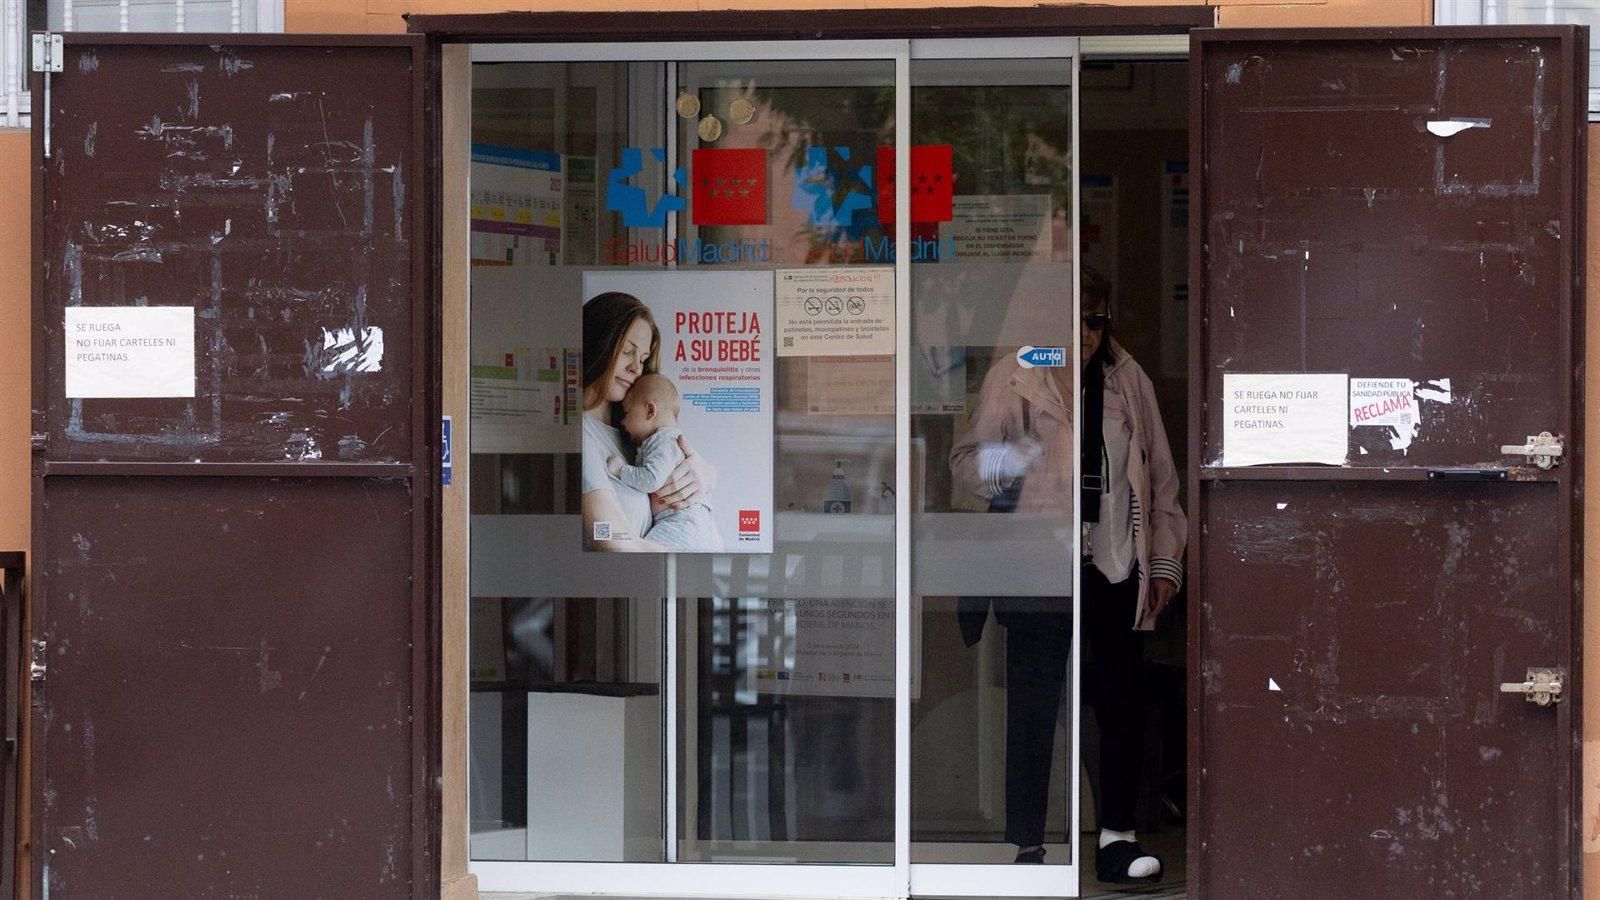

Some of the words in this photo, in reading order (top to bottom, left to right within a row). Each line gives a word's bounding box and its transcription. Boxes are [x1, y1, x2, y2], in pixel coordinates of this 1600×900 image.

[675, 311, 760, 334] PROTEJA
[76, 323, 87, 332] SE
[89, 323, 121, 332] RUEGA
[77, 339, 91, 347] NO
[94, 339, 117, 347] FIJAR
[119, 338, 163, 347] CARTELES
[166, 338, 176, 346] NI
[674, 340, 686, 361] A
[691, 340, 712, 361] SU
[718, 335, 760, 361] BEBÉ
[1032, 352, 1061, 361] AUTO
[697, 366, 739, 374] bronquiolitis
[1234, 390, 1245, 399] SE
[1246, 390, 1278, 399] RUEGA
[1279, 390, 1294, 399] NO
[1296, 390, 1319, 399] FIJAR
[1234, 405, 1277, 414] CARTELES
[1279, 405, 1288, 414] NI
[1354, 395, 1411, 422] RECLAMA
[1234, 420, 1286, 429] PEGATINAS.
